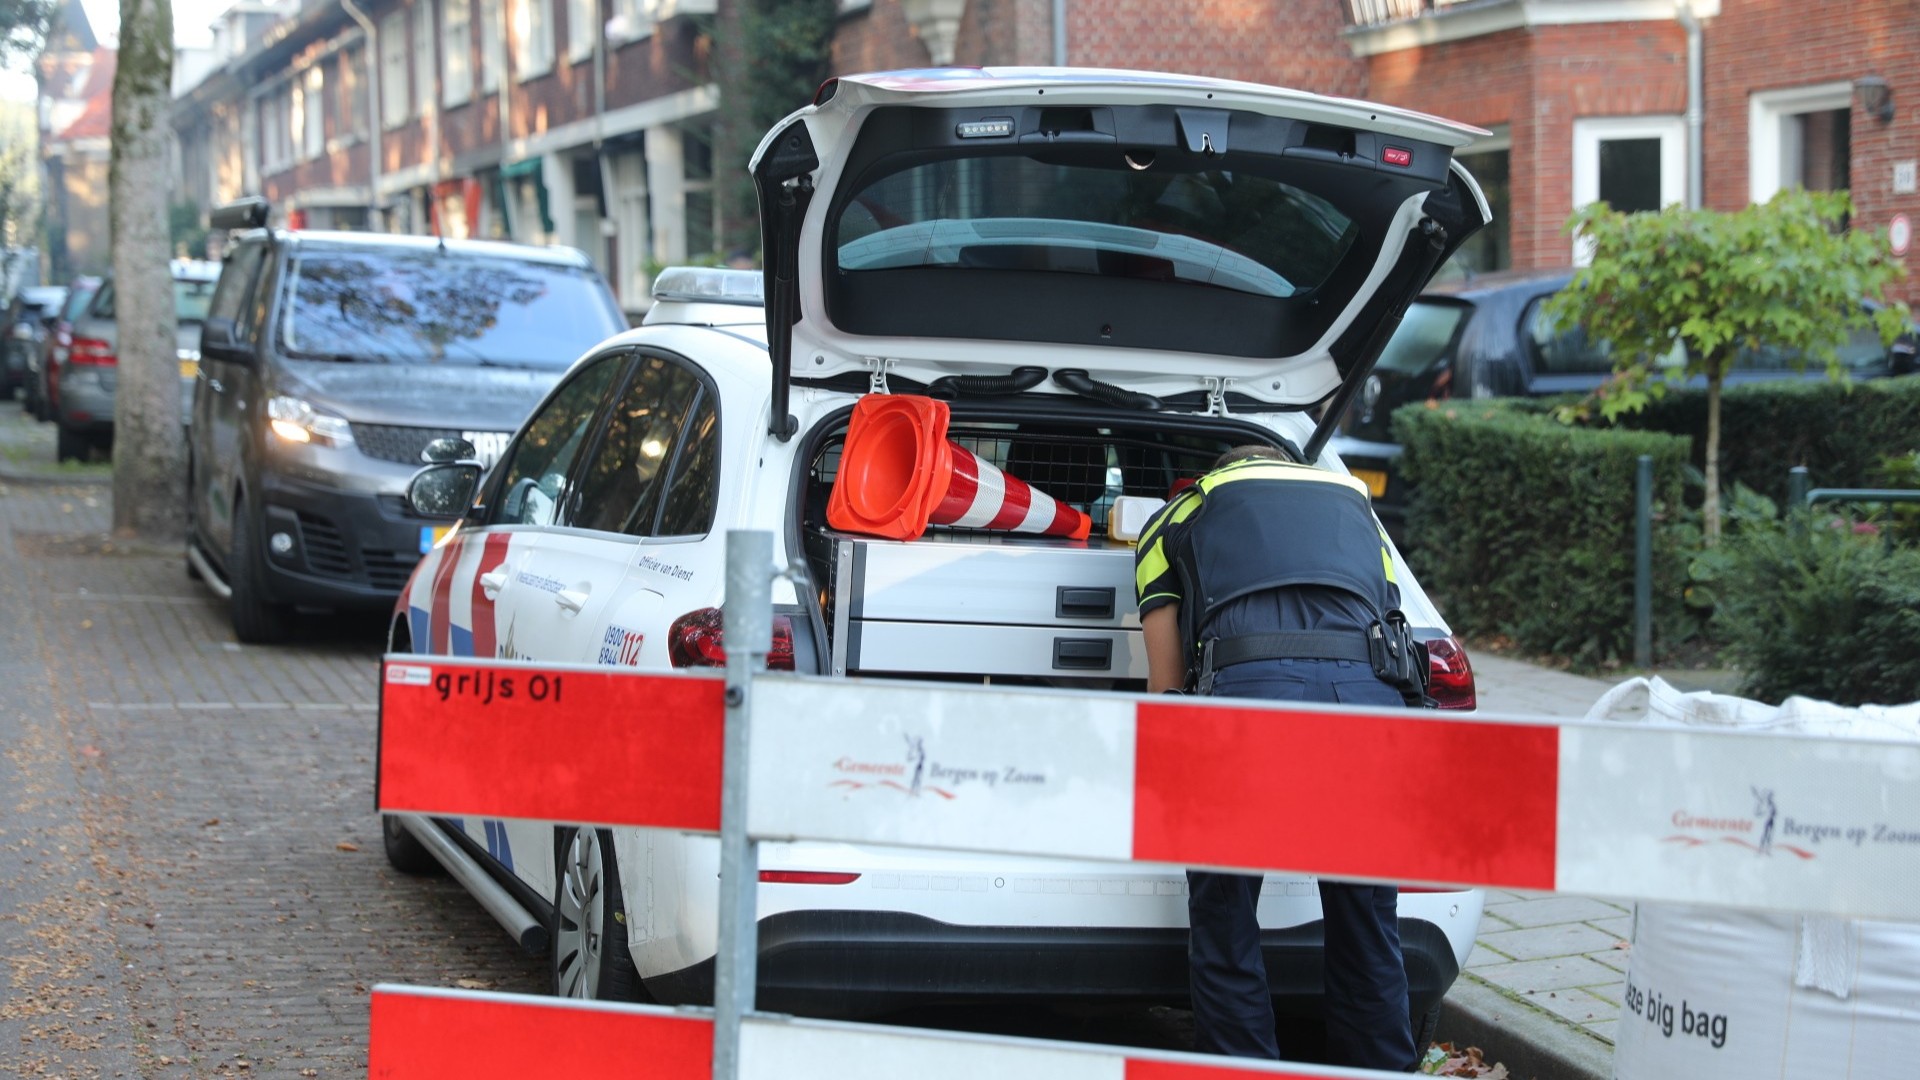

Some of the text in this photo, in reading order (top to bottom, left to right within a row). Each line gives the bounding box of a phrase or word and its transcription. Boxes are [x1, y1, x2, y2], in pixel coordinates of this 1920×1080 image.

[639, 555, 694, 581] Officier van Dienst
[604, 625, 625, 647] 0900
[619, 631, 644, 667] 112
[435, 669, 514, 705] grijs
[834, 756, 1046, 787] Gemeente Bergen op Zoom
[1672, 810, 1920, 846] Gemeente Bergen op Zoom
[1647, 988, 1674, 1038] big
[1682, 999, 1728, 1049] bag
